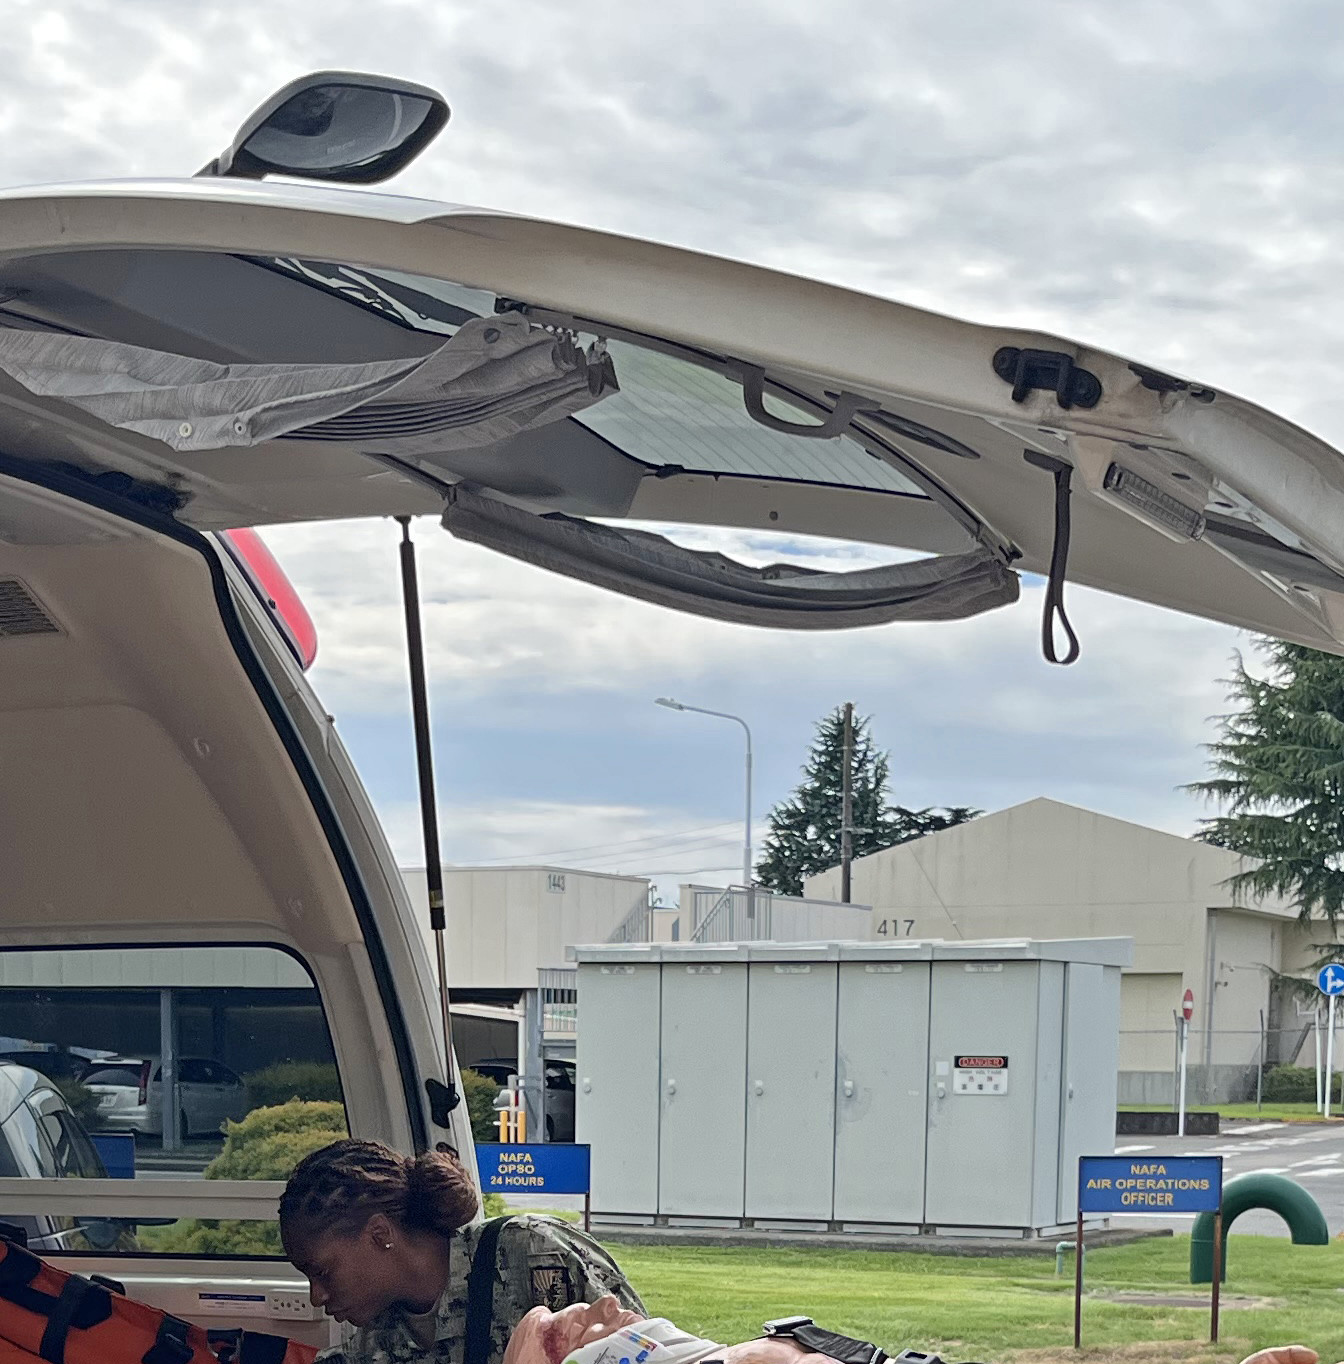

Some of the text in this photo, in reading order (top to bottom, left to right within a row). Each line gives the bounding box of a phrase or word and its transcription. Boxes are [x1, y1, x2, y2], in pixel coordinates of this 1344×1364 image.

[876, 919, 915, 937] 417
[961, 1058, 1001, 1067] DANGER
[499, 1152, 533, 1163] NAFA
[1130, 1164, 1167, 1176] NAFA
[490, 1175, 545, 1187] 24 HOURS
[1086, 1178, 1210, 1191] AIR OPERATIONS
[1120, 1191, 1174, 1206] OFFICER
